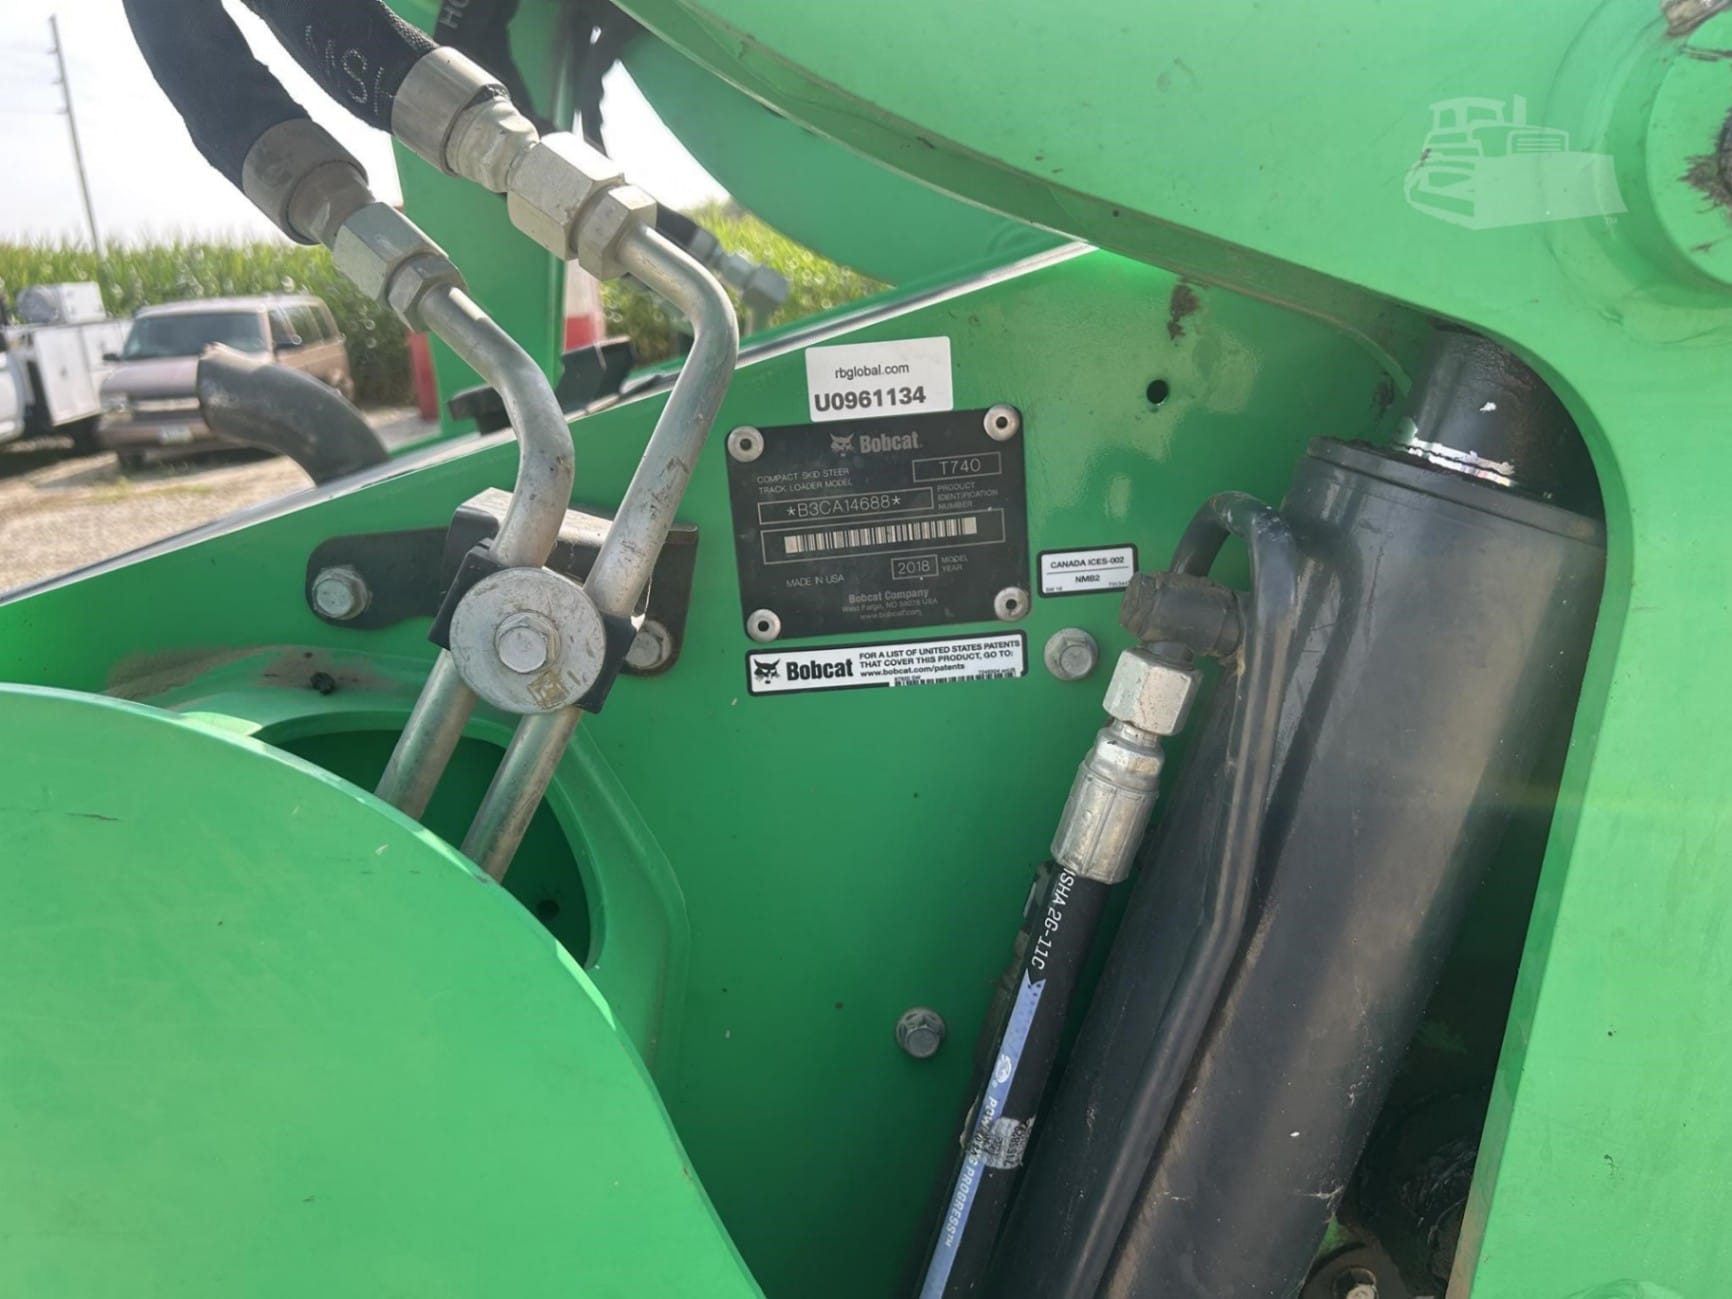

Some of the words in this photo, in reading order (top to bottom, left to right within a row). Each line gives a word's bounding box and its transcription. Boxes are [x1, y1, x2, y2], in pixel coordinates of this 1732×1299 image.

[834, 362, 909, 381] rbglobal.com
[814, 384, 926, 412] U0961134
[859, 430, 919, 453] Bobcat
[939, 458, 981, 475] T740
[756, 472, 797, 483] COMPACT
[801, 470, 820, 479] SKID
[823, 468, 849, 477] STEER
[759, 485, 785, 494] TRACK
[789, 482, 822, 491] LOADER
[825, 478, 852, 487] MODEL
[936, 481, 976, 491] PRODUCT
[937, 488, 998, 501] IDENTIFICATION
[938, 500, 972, 510] NUMBER
[897, 560, 930, 574] 2018
[941, 555, 967, 564] MODEL
[1050, 559, 1086, 569] CANADA
[1087, 555, 1124, 565] ICES-002
[786, 577, 811, 587] MADE
[815, 576, 823, 584] IN
[825, 574, 844, 583] USA
[848, 592, 882, 603] Bobcat
[884, 587, 929, 601] Company
[919, 646, 949, 655] UNITED
[951, 643, 982, 652] STATES
[983, 639, 1020, 649] PATENTS
[859, 660, 882, 668] THAT
[884, 657, 914, 666] COVER
[916, 655, 935, 663] THIS
[937, 651, 981, 662] PRODUCT,
[785, 655, 853, 681] Bobcat
[860, 662, 964, 677] www.bobcat.com/patents
[1030, 906, 1064, 970] 2G-11C
